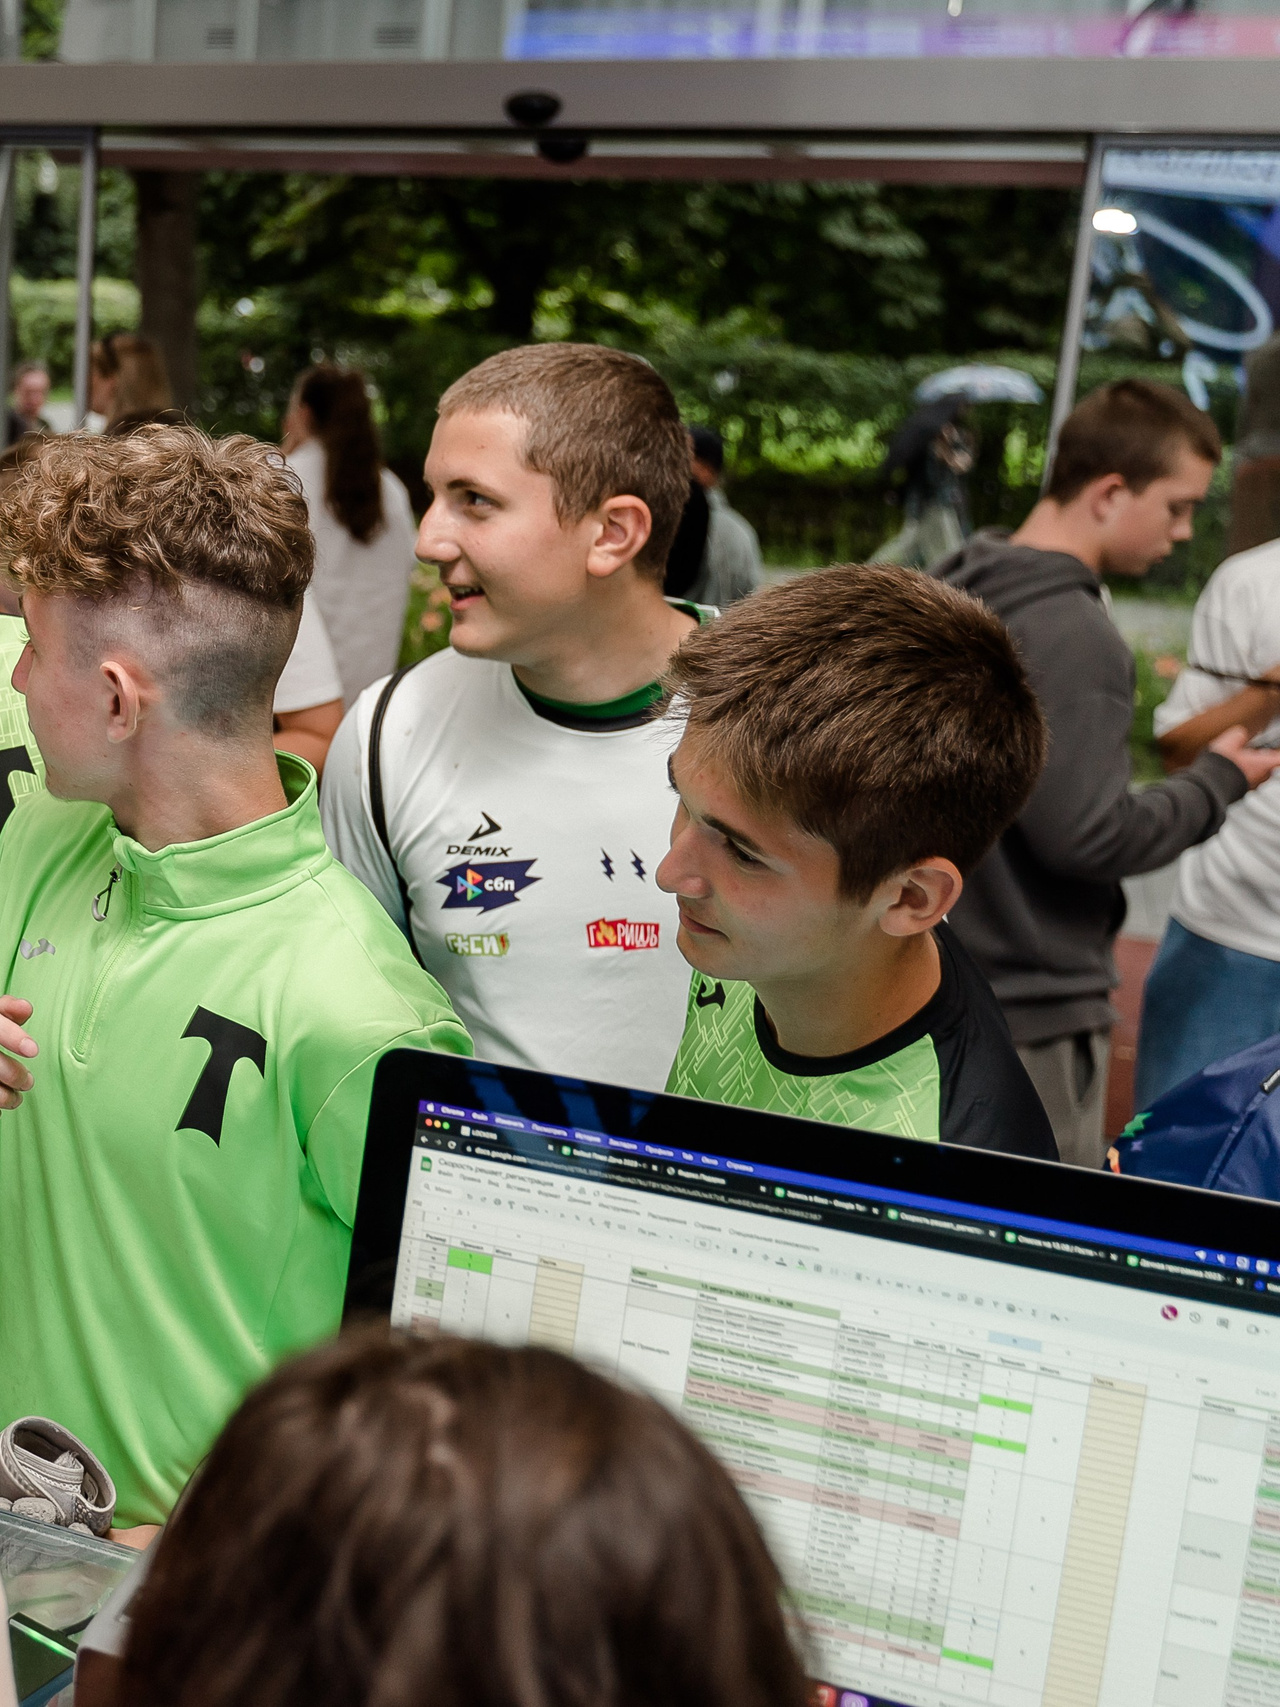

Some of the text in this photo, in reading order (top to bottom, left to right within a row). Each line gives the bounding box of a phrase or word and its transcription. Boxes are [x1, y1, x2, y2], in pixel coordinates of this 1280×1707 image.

[446, 844, 513, 857] DEMIX
[484, 876, 515, 892] сбп
[438, 1158, 474, 1172] Скорость
